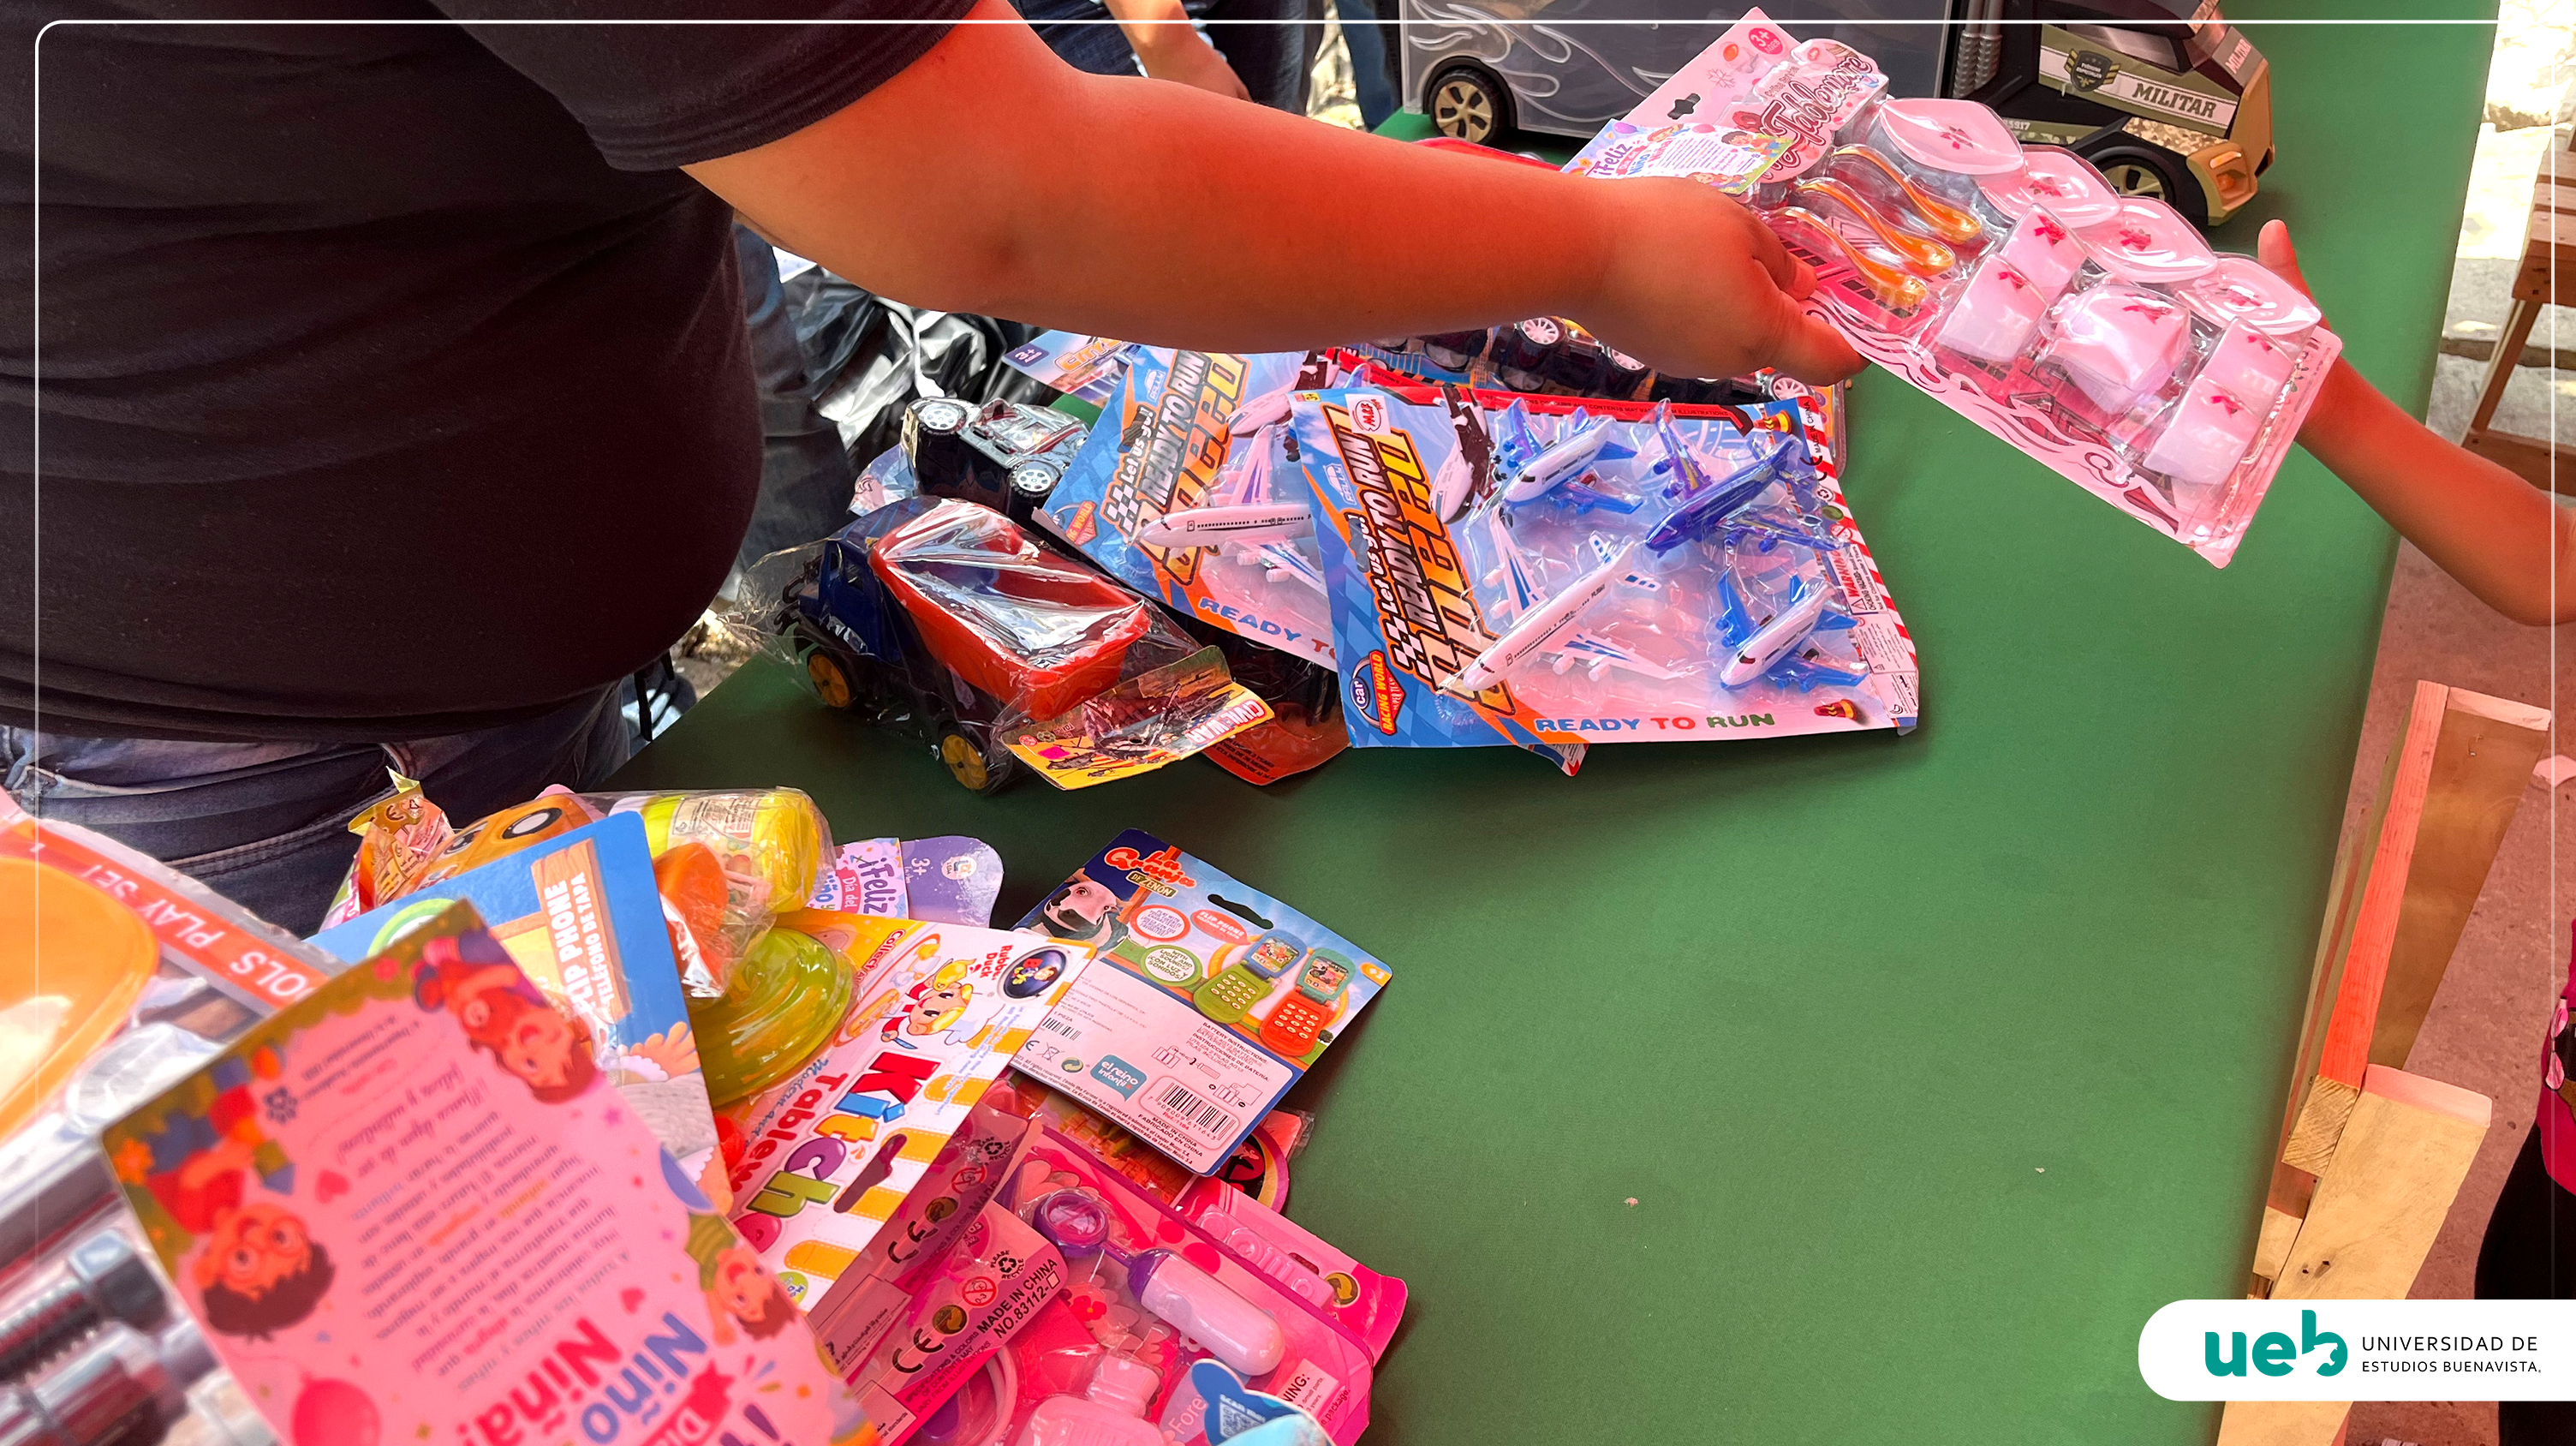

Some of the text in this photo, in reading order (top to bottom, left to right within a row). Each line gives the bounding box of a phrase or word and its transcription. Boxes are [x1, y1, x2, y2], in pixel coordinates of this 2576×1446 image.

[1750, 29, 1769, 47] 3+
[2132, 82, 2217, 119] MILITAR
[1136, 349, 1208, 505] READY TO RUN
[1804, 402, 1814, 423] CHINA
[1130, 437, 1146, 457] us
[1811, 433, 1822, 453] MADE
[1120, 456, 1142, 484] Let
[1341, 429, 1383, 489] RUN
[1072, 501, 1094, 530] WORLD
[1364, 487, 1399, 533] TO
[1369, 553, 1384, 577] us
[1379, 529, 1439, 631] READY
[1379, 589, 1398, 614] Let
[1198, 597, 1302, 643] READY
[1357, 682, 1367, 705] car
[1373, 653, 1394, 732] RACING WORLD
[1184, 697, 1265, 747] CIVIL WAR
[1536, 713, 1774, 732] READY TO RUN
[911, 857, 930, 875] 3+
[1105, 847, 1196, 888] Granja
[1149, 850, 1182, 871] La
[82, 865, 139, 898] SET
[843, 876, 857, 909] Día del
[856, 857, 897, 915] ¡Feliz
[1139, 875, 1172, 898] ZENÓN
[145, 905, 225, 948] PLAY
[571, 871, 616, 1004] TELÉFONO DE TAPA
[1199, 911, 1244, 937] FLIP PHONE
[545, 880, 595, 1013] FLIP PHONE
[864, 929, 906, 978] Collect
[1160, 949, 1192, 968] LIGHT AND
[1172, 950, 1188, 960] WITH
[979, 953, 998, 978] Duck
[1148, 959, 1182, 980] SONIDOS!
[1159, 953, 1189, 971] SOUNDS!
[1166, 963, 1180, 973] LUZ
[1057, 1012, 1073, 1022] PIEZA
[1185, 1040, 1201, 1052] PILAS
[1192, 1032, 1236, 1062] INSTRUCCIONES
[1202, 1022, 1268, 1064] BATTERY INSTRUCTIONS:
[776, 1059, 829, 1107] Modern
[1096, 1067, 1128, 1089] infantil
[1100, 1061, 1139, 1088] el reino
[1137, 1113, 1203, 1157] FABRICADO EN CHINA
[1151, 1116, 1171, 1131] MADE
[1177, 1132, 1197, 1147] CHINA
[991, 1250, 1010, 1268] PLEASE
[1002, 1258, 1024, 1279] RECYCLE
[976, 1258, 1057, 1334] MADE IN CHINA
[581, 1312, 707, 1445] Niño
[904, 1357, 951, 1404] SPECIFICATIONS
[953, 1329, 979, 1354] COLORS
[921, 1345, 975, 1398] OF CONTENTS MAY
[915, 1396, 933, 1414] VARY
[931, 1379, 951, 1399] FROM
[1327, 1389, 1351, 1422] package.
